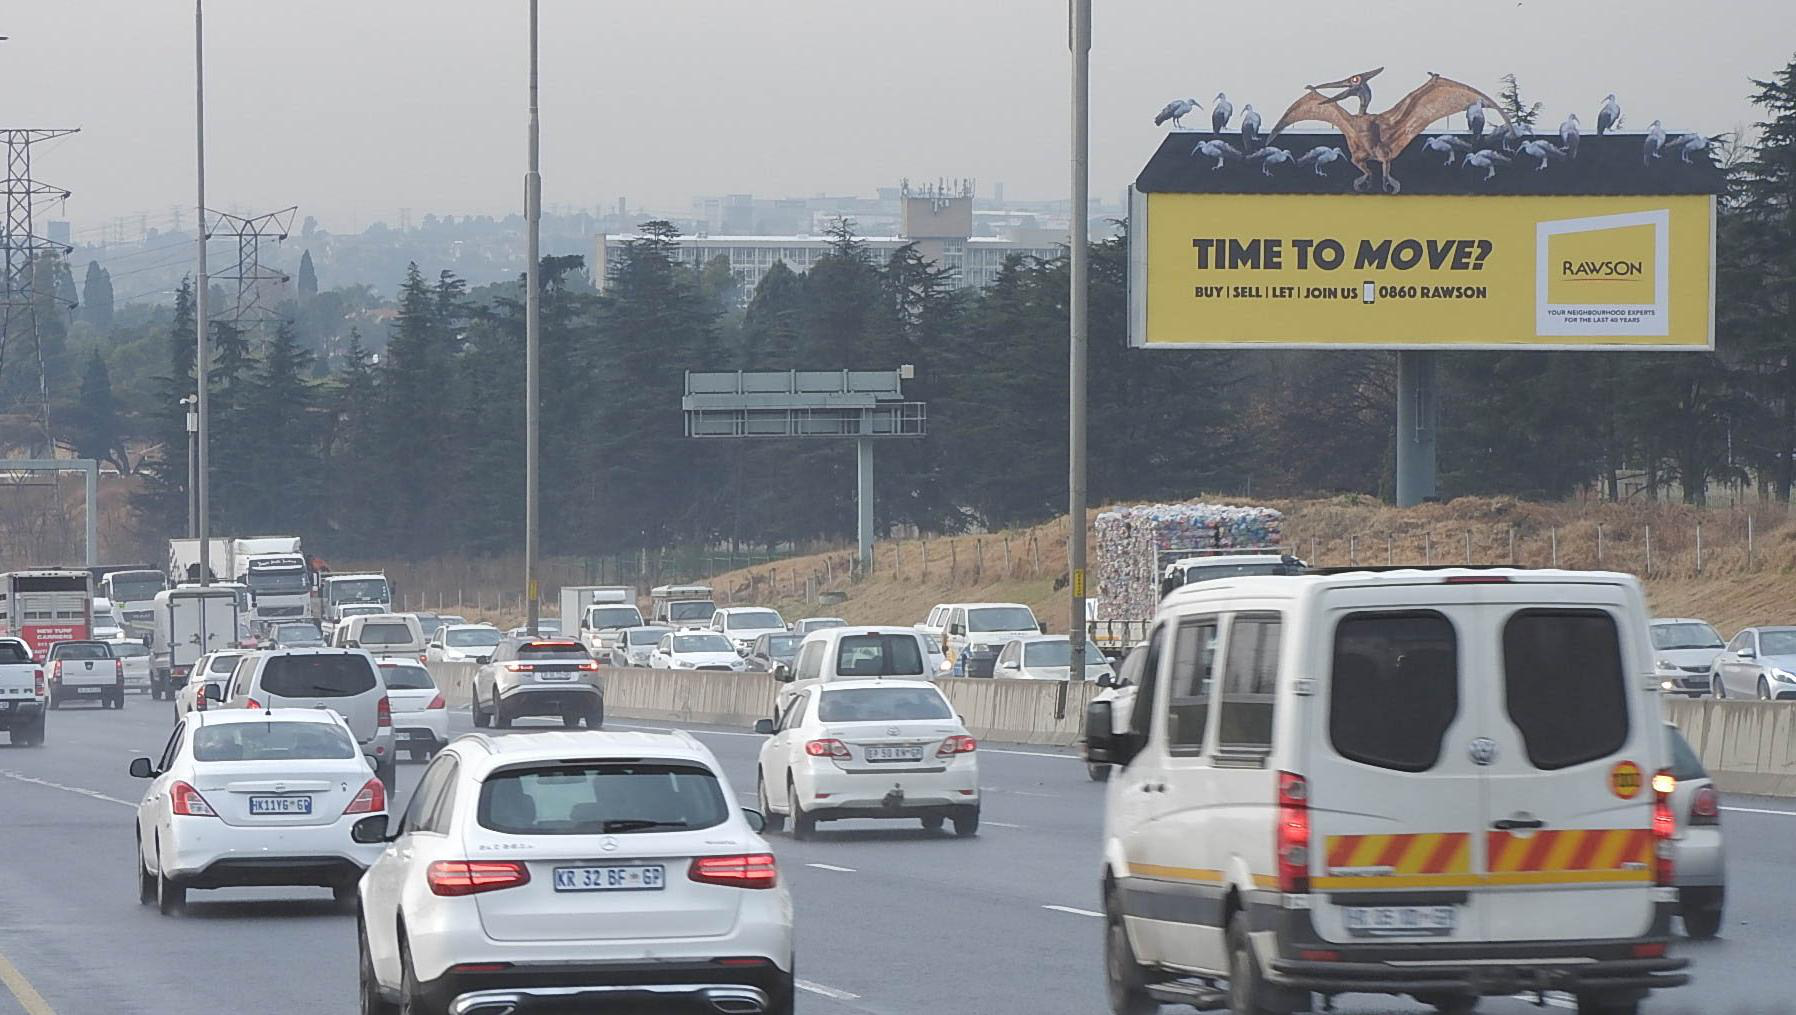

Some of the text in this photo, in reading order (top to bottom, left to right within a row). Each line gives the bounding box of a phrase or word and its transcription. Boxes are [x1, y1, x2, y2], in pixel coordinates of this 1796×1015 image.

[1192, 238, 1493, 271] TIME TO MOVE?
[1562, 260, 1642, 276] RAWSON
[1195, 286, 1487, 299] BUY SELL LET JOIN US 0860 RAWSON
[556, 869, 576, 887] KR
[582, 869, 602, 886] 32
